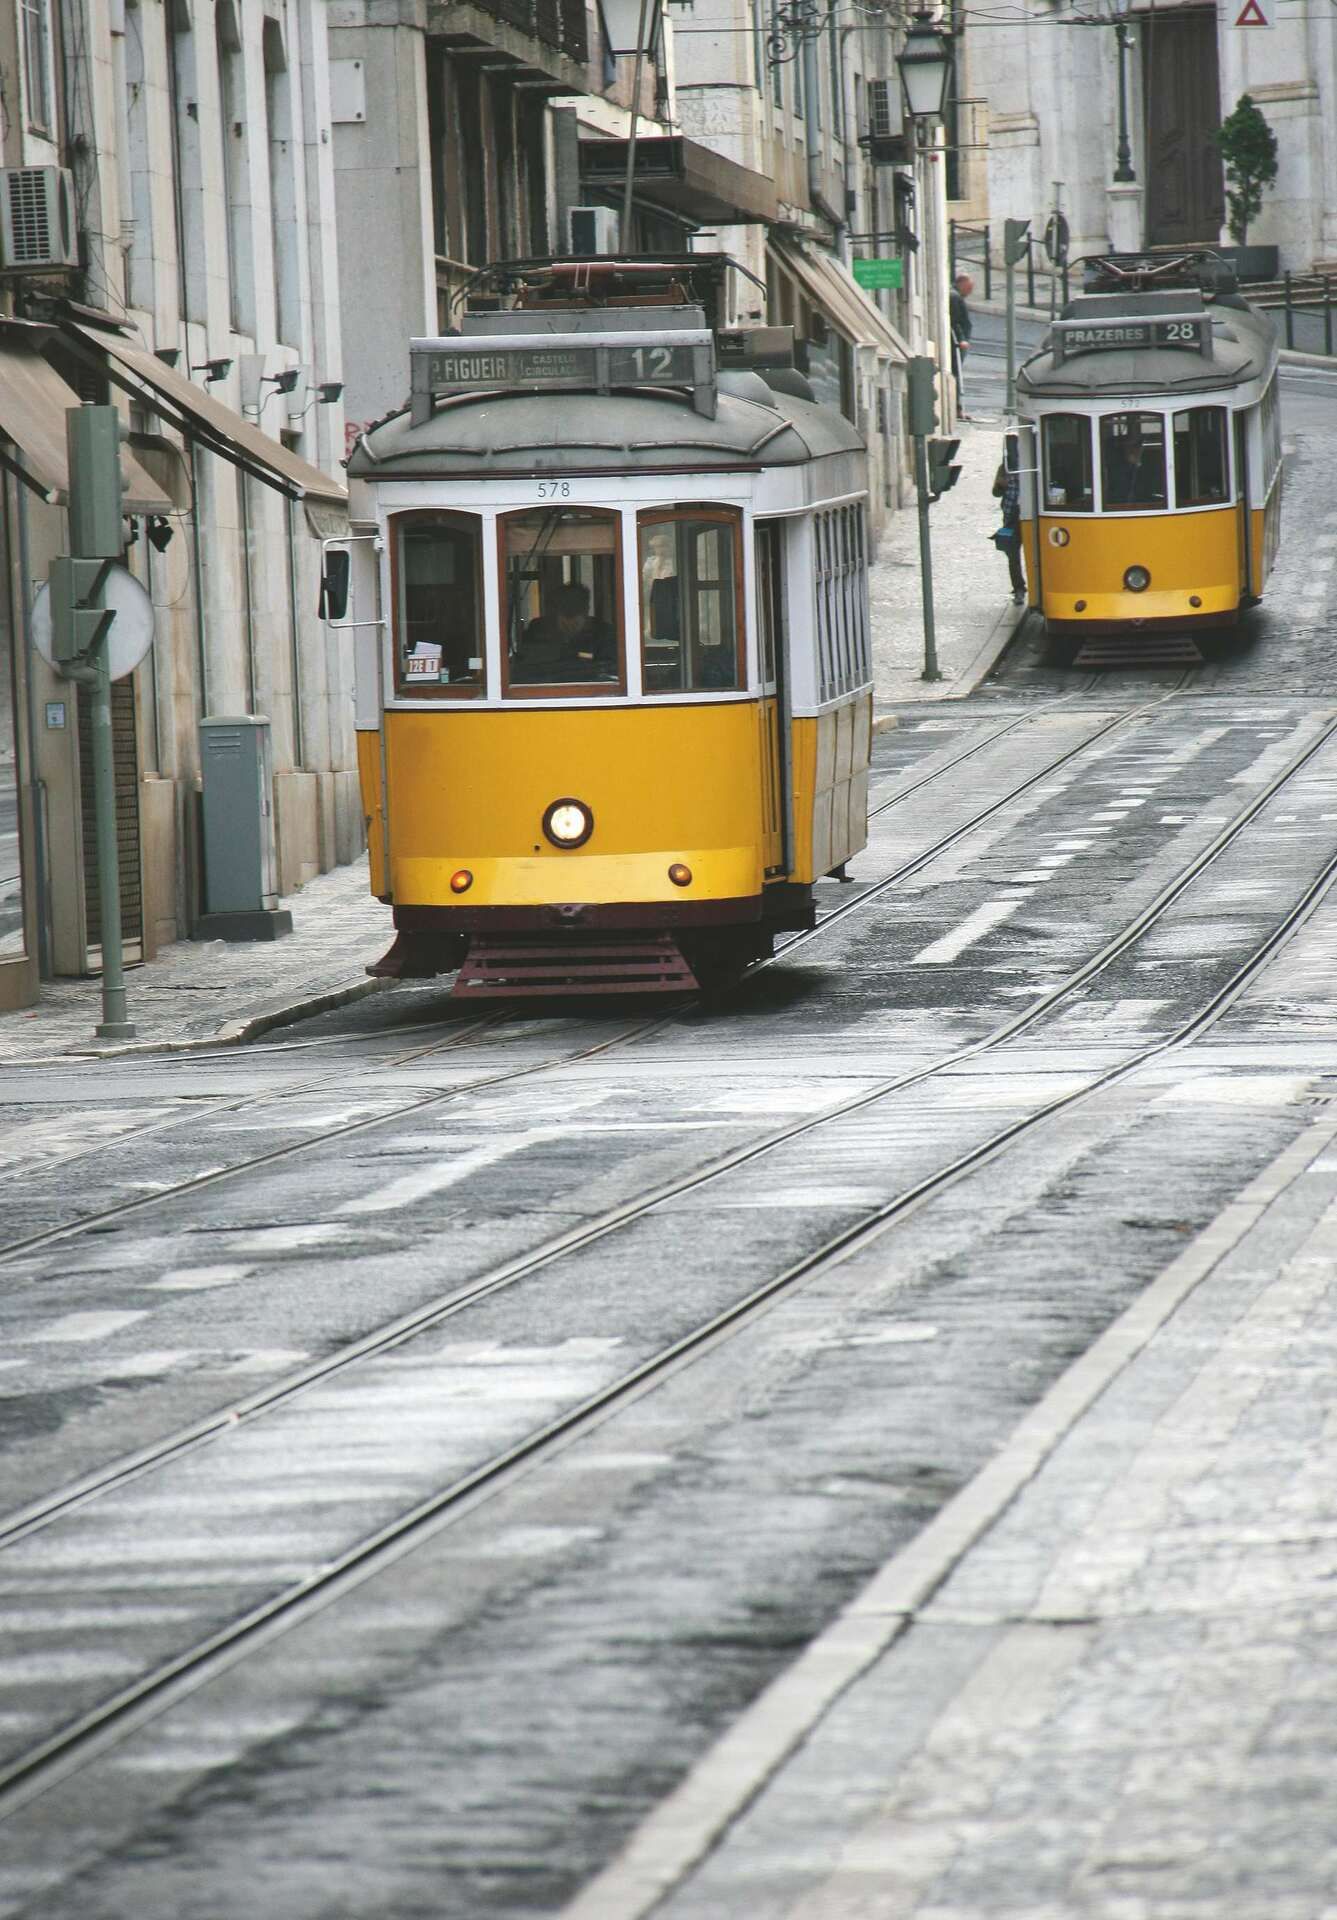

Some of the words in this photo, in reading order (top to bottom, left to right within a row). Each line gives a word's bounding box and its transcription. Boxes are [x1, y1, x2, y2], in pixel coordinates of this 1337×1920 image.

[1065, 328, 1144, 343] PRAZERES
[1166, 322, 1194, 340] 28
[444, 357, 513, 381] FIGUEIR
[631, 347, 673, 379] 12
[537, 481, 570, 498] 578
